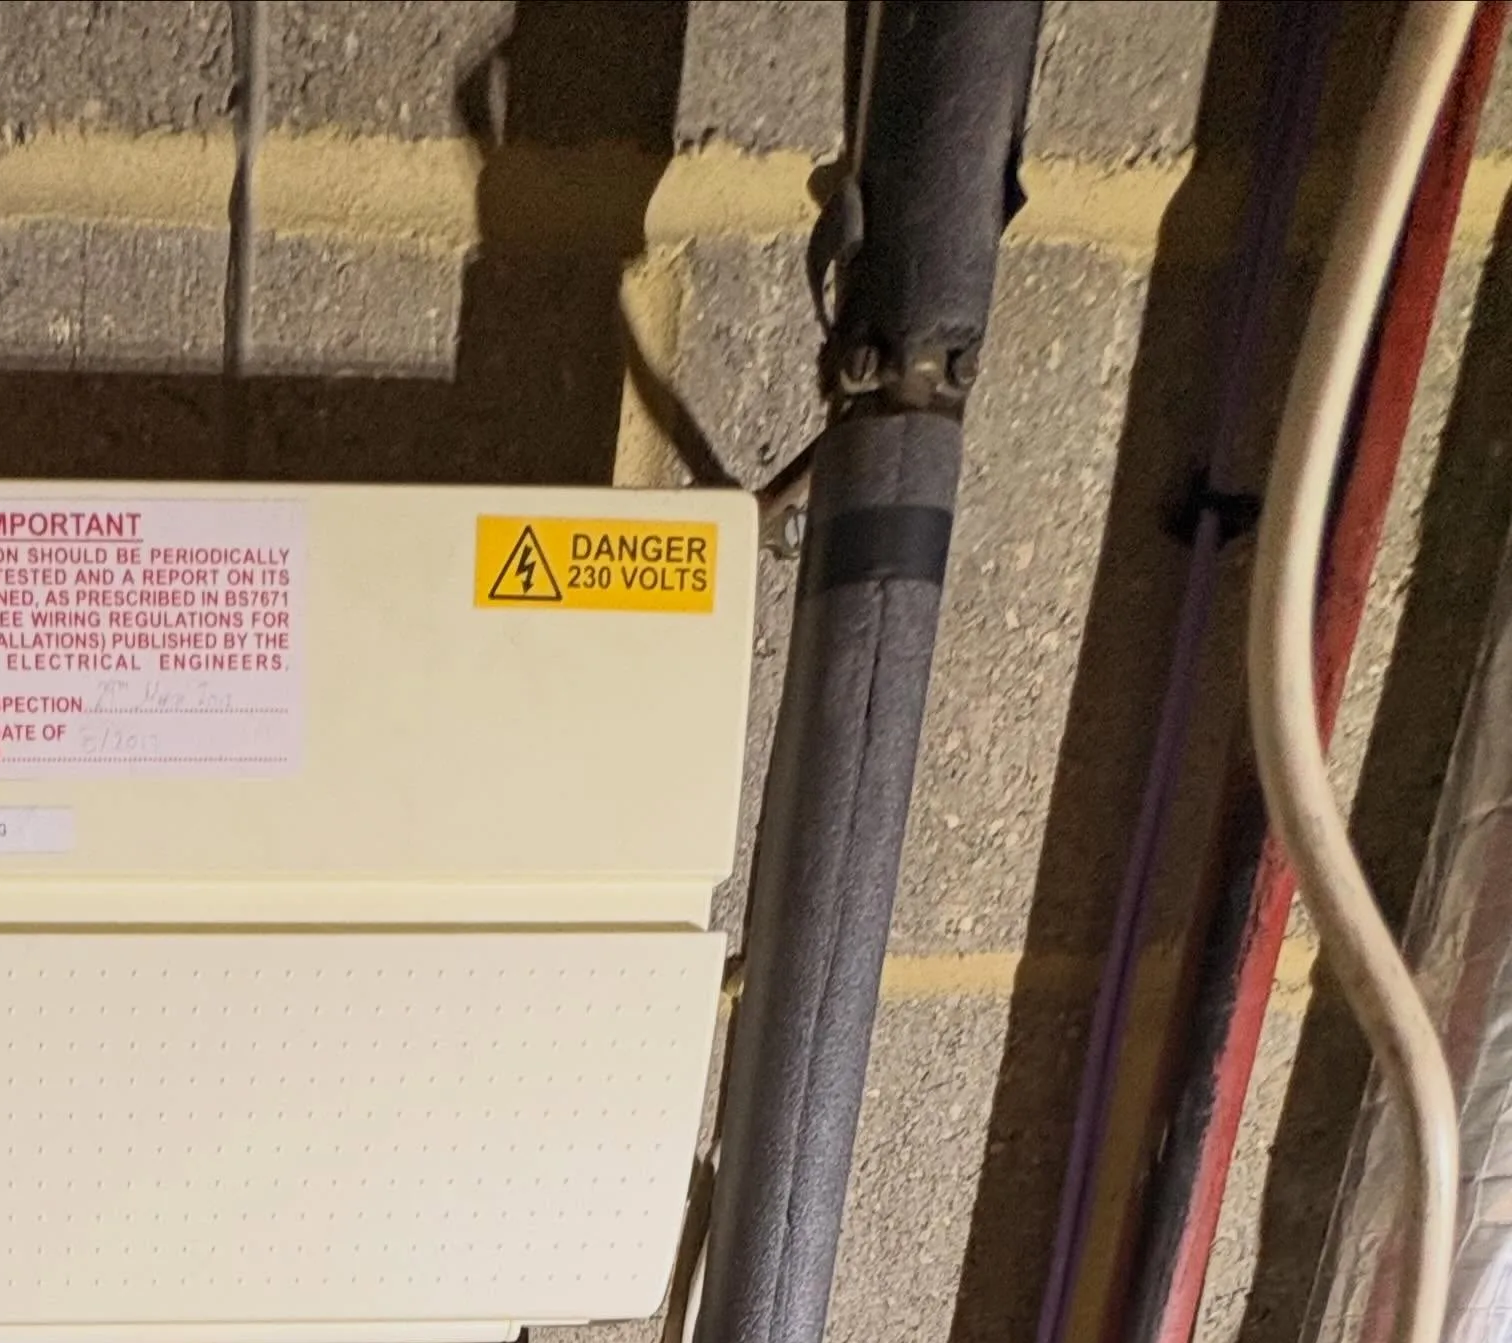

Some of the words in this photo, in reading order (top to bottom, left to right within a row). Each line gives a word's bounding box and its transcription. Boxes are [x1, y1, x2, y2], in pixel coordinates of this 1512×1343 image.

[27, 547, 107, 565] SHOULD
[116, 547, 141, 565] BE
[150, 547, 290, 566] PERIODICALLY
[571, 533, 707, 564] DANGER
[74, 568, 115, 586] AND
[121, 568, 135, 586] A
[142, 568, 220, 586] REPORT
[227, 568, 254, 586] ON
[261, 568, 290, 586] ITS
[568, 565, 611, 590] 230
[621, 566, 708, 592] VOLTS
[45, 589, 70, 607] AS
[76, 589, 195, 608] PRESCRIBED
[201, 590, 218, 608] IN
[224, 589, 288, 608] BS7671
[30, 610, 101, 629] WIRING
[109, 610, 244, 629] REGULATIONS
[251, 610, 290, 629] FOR
[112, 632, 218, 650] PUBLISHED
[223, 632, 248, 650] BY
[253, 632, 289, 650] THE
[7, 652, 141, 671] ELECTRICAL
[42, 724, 67, 741] OF
